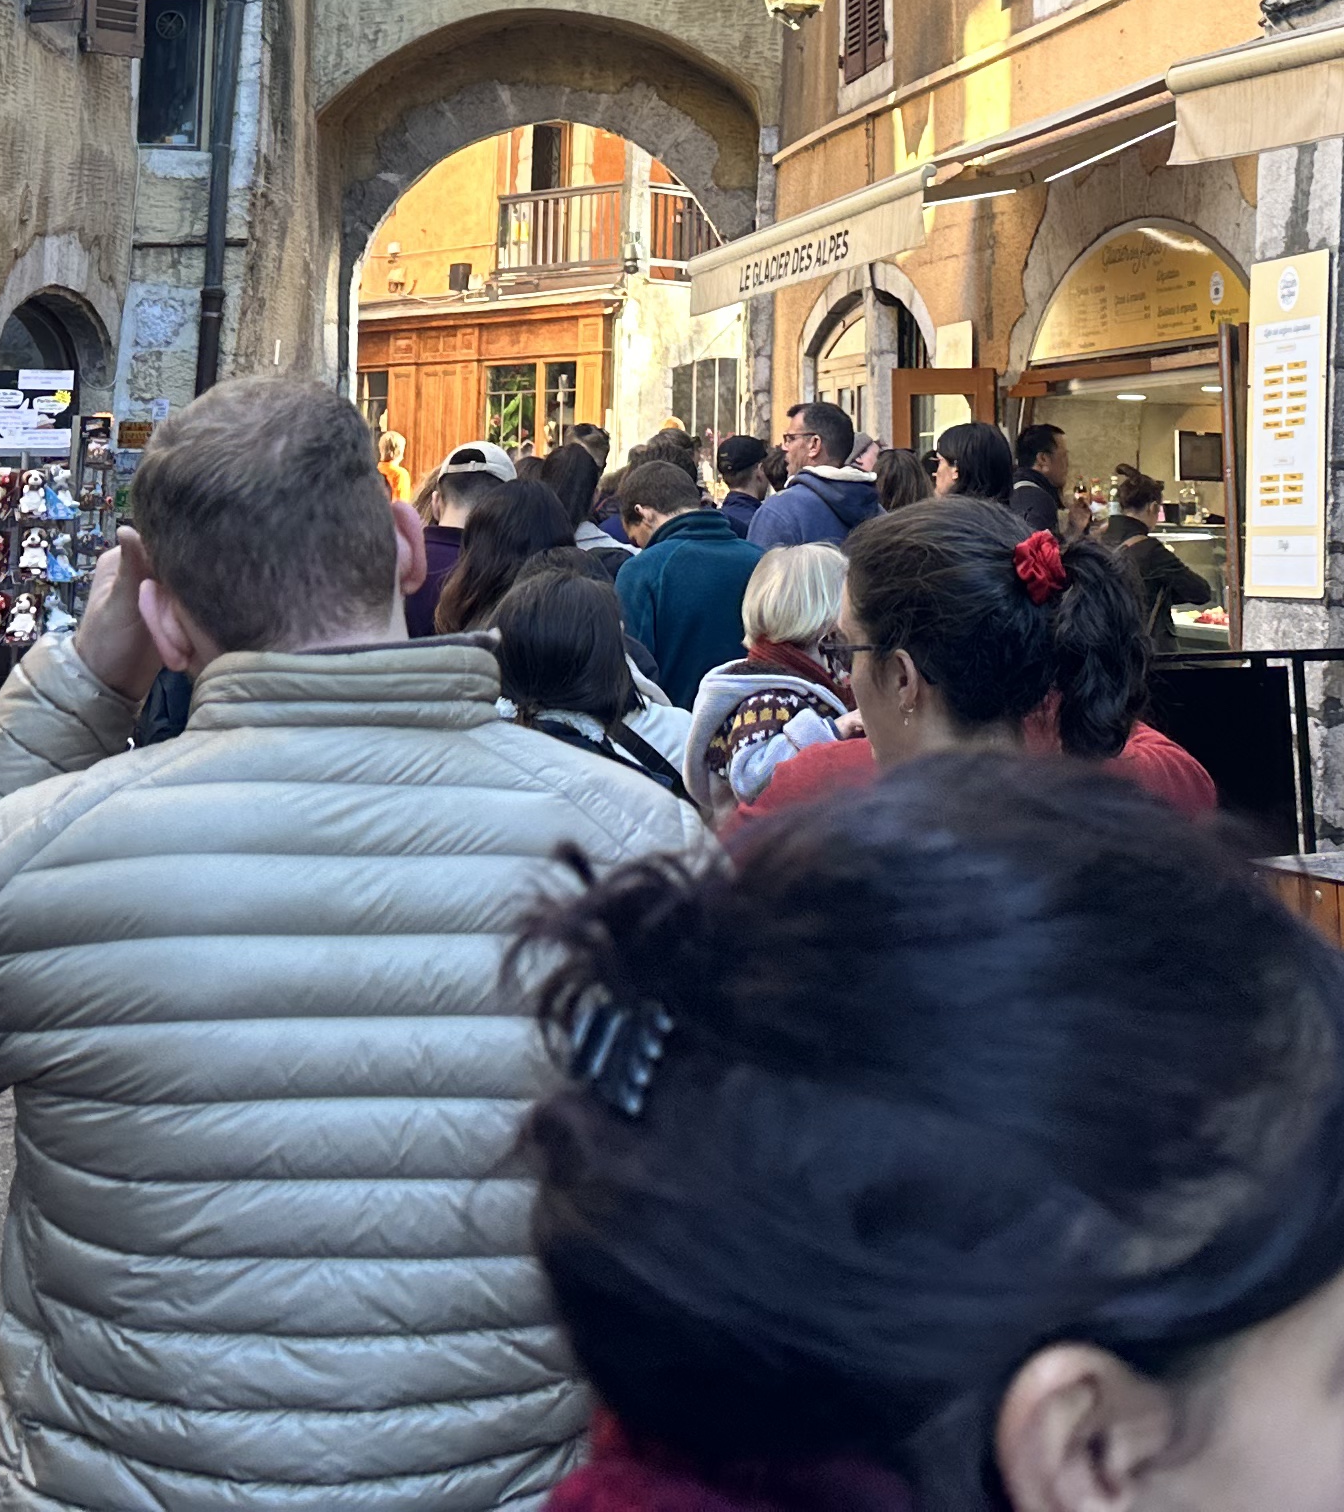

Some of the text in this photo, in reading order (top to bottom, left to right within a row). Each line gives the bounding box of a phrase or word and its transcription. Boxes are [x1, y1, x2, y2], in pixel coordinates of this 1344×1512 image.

[739, 230, 849, 292] LE GLACIER DES ALPES
